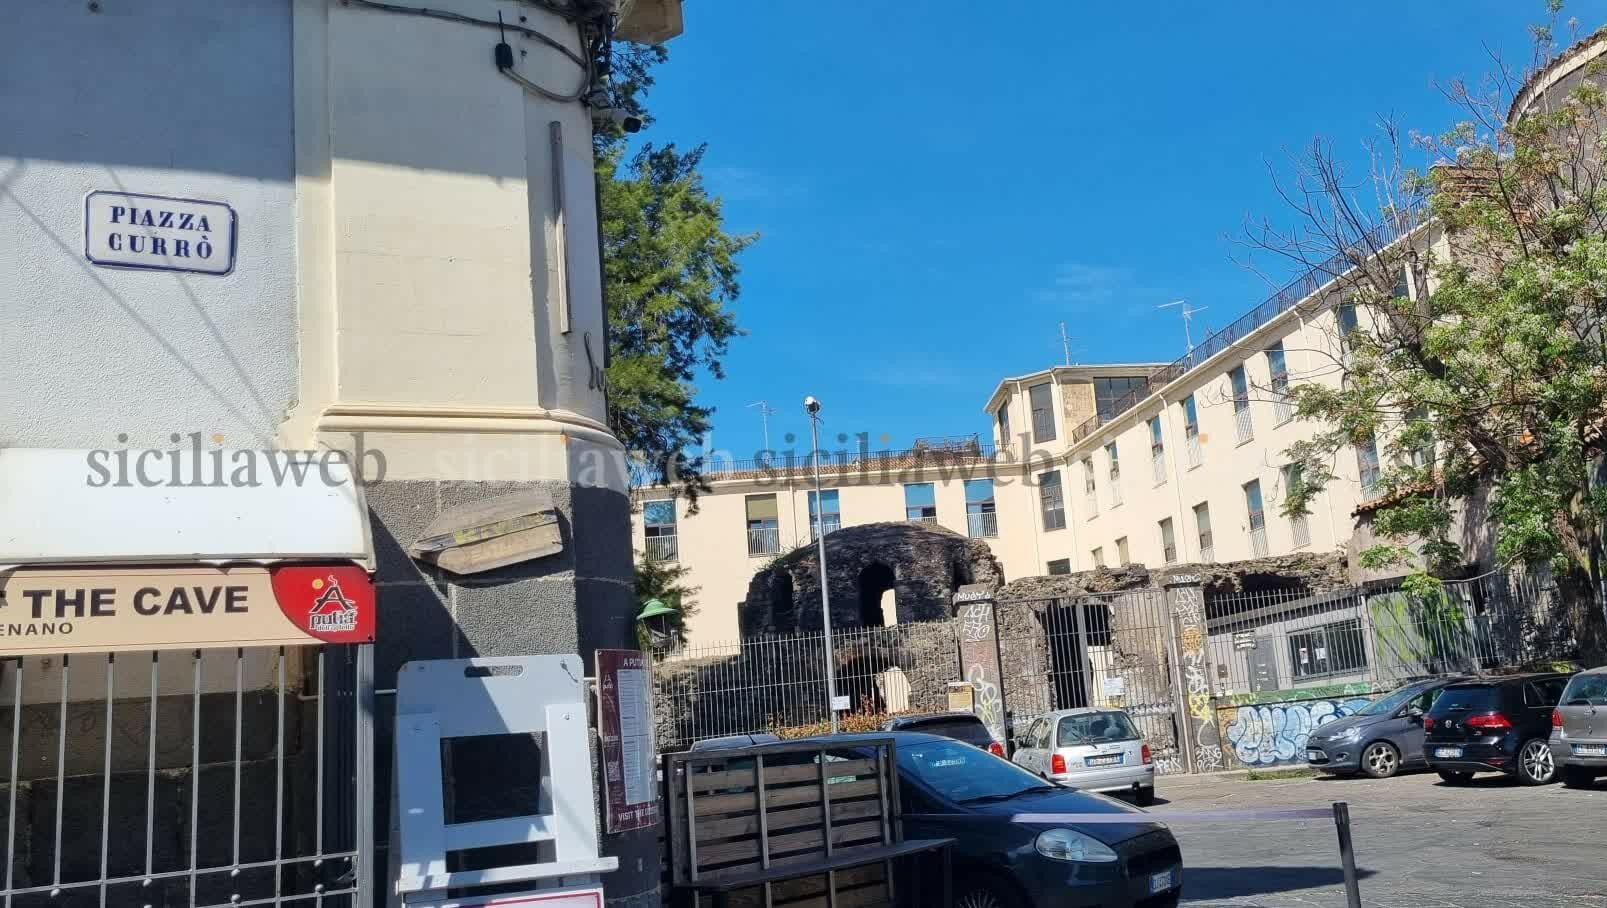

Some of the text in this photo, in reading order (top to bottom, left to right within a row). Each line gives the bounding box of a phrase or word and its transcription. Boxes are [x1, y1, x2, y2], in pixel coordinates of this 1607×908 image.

[109, 205, 213, 233] PIAZZA
[108, 232, 213, 259] CURRÒ
[23, 588, 117, 619] THE
[133, 586, 250, 616] CAVE
